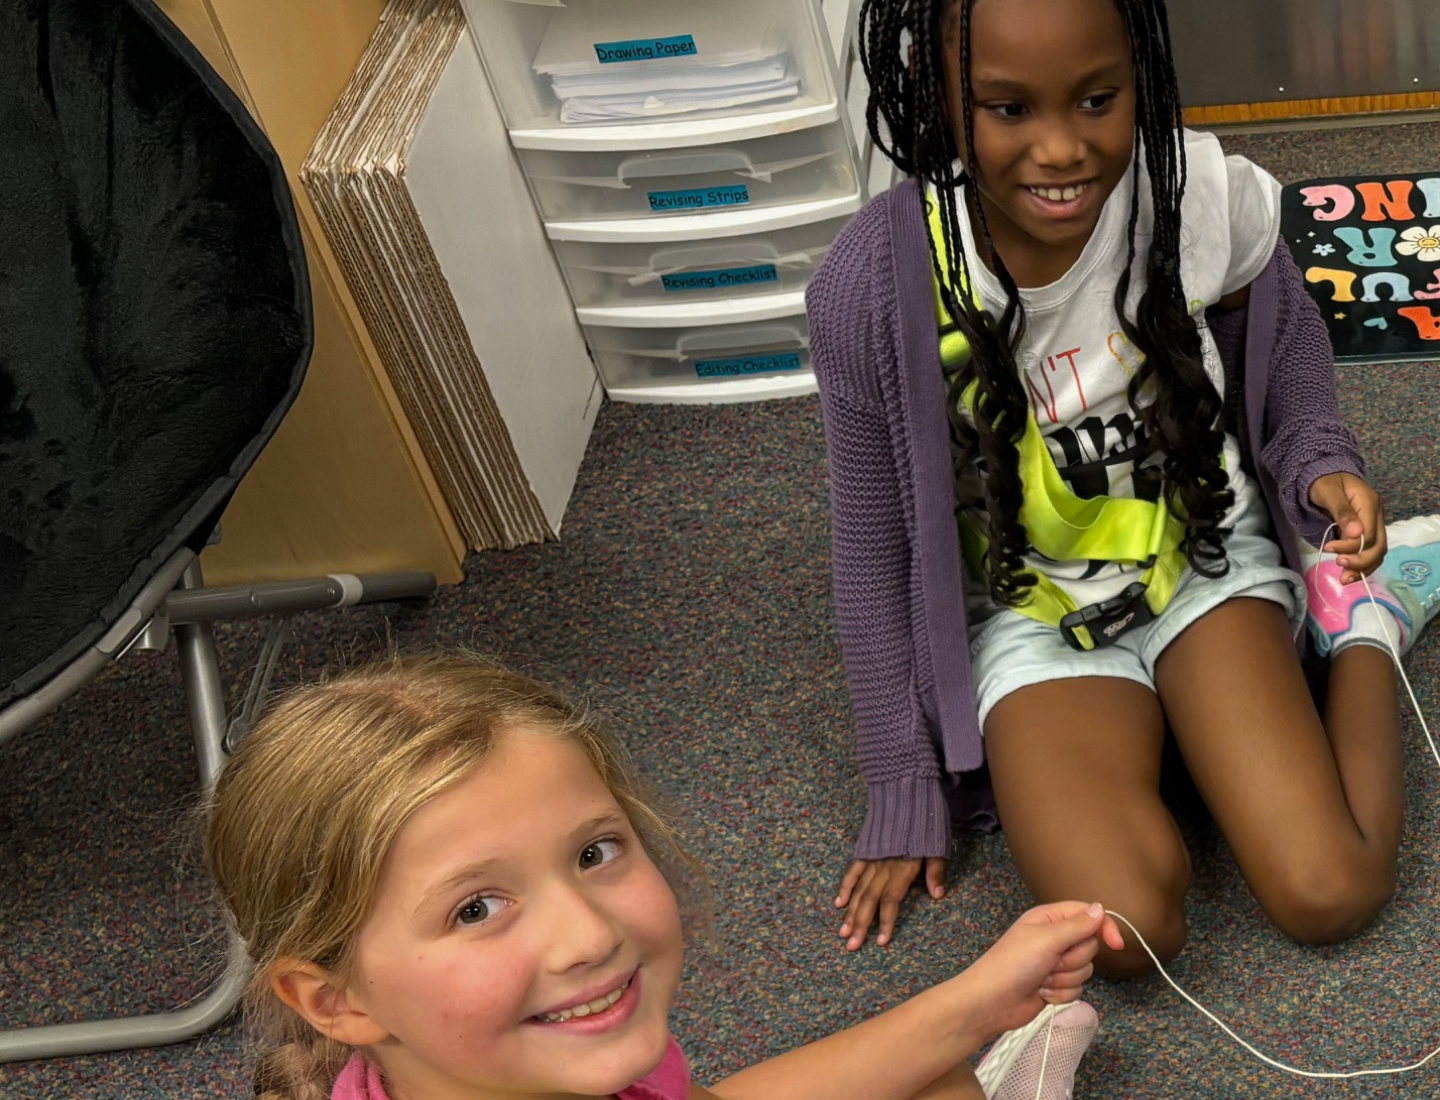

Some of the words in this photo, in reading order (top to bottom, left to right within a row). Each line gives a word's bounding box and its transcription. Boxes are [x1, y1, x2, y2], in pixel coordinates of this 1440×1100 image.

[596, 45, 654, 60] Drawing
[655, 41, 696, 57] Paper
[648, 192, 703, 208] Revising
[707, 189, 749, 203] Strips
[661, 274, 715, 288] Revising
[718, 267, 777, 284] Checklist
[695, 362, 741, 376] Editing
[743, 356, 800, 372] Checklist
